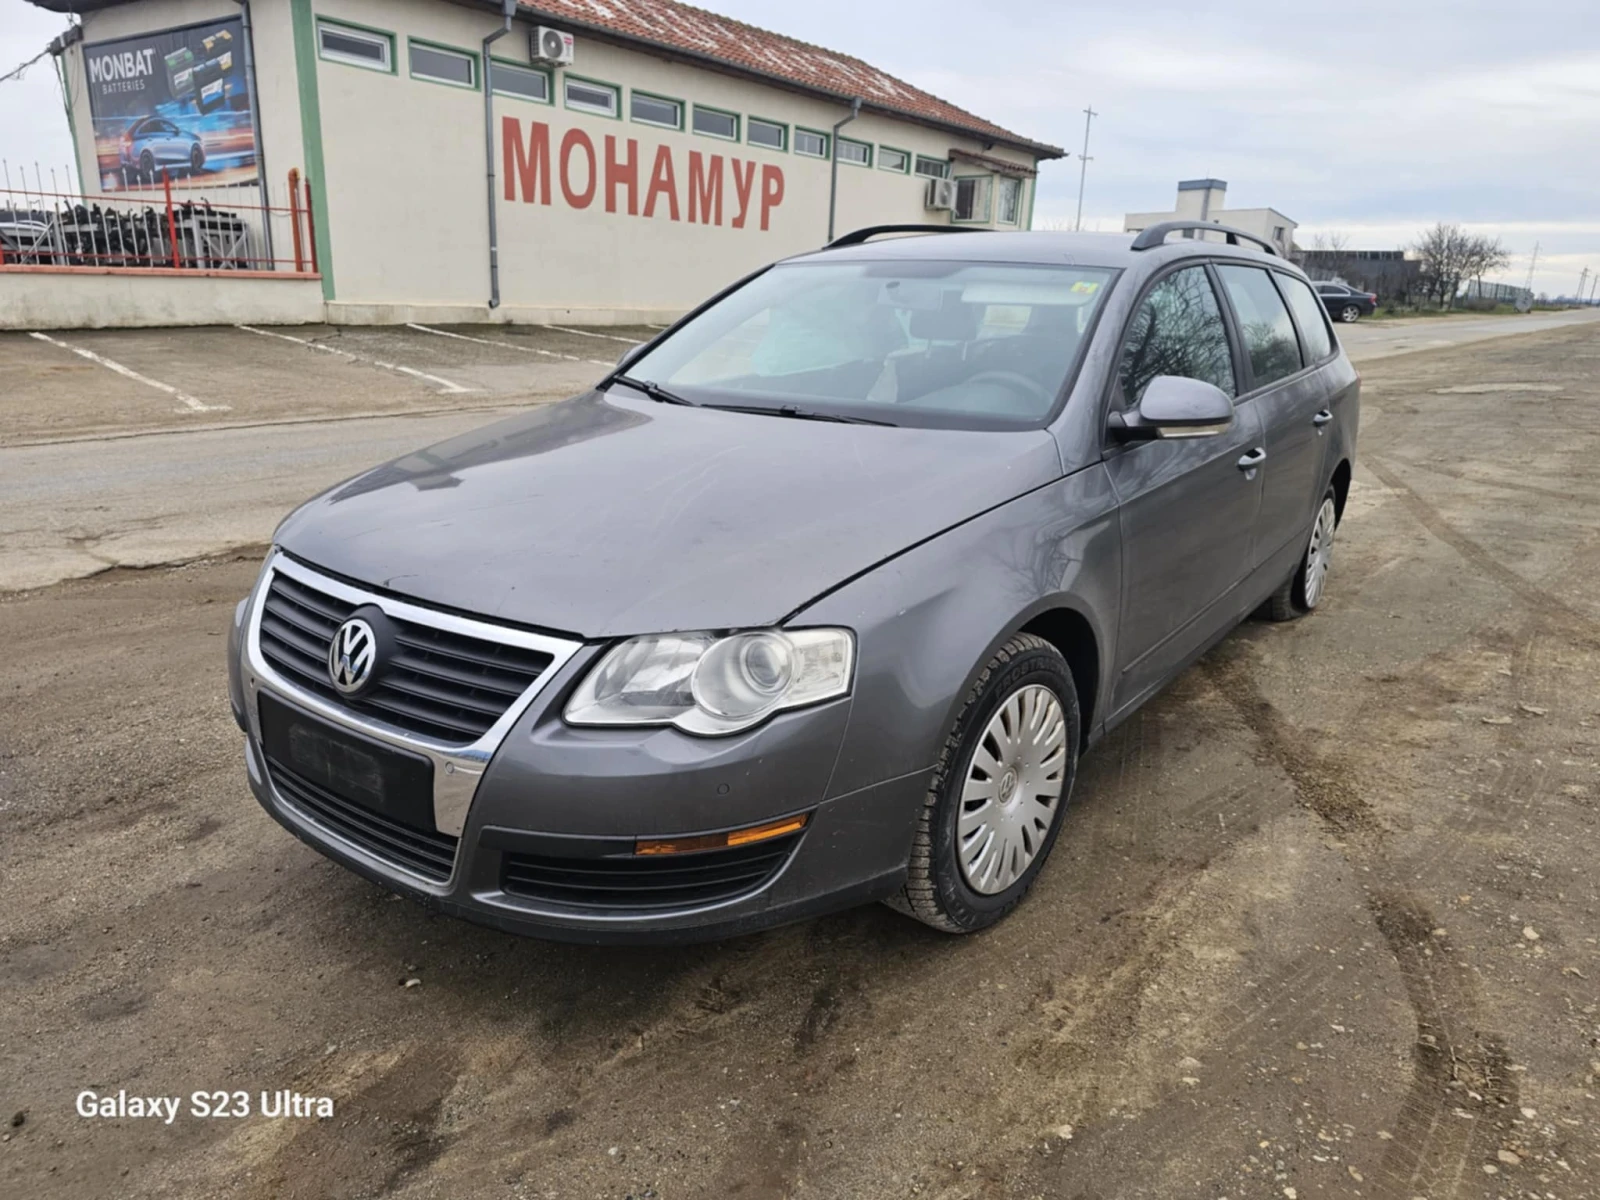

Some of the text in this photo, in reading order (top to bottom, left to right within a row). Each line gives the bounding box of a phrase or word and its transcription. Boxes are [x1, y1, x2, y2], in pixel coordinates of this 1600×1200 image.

[89, 48, 153, 83] MONBAT
[102, 79, 145, 95] BATTERIES
[502, 116, 785, 231] МОНАМУР
